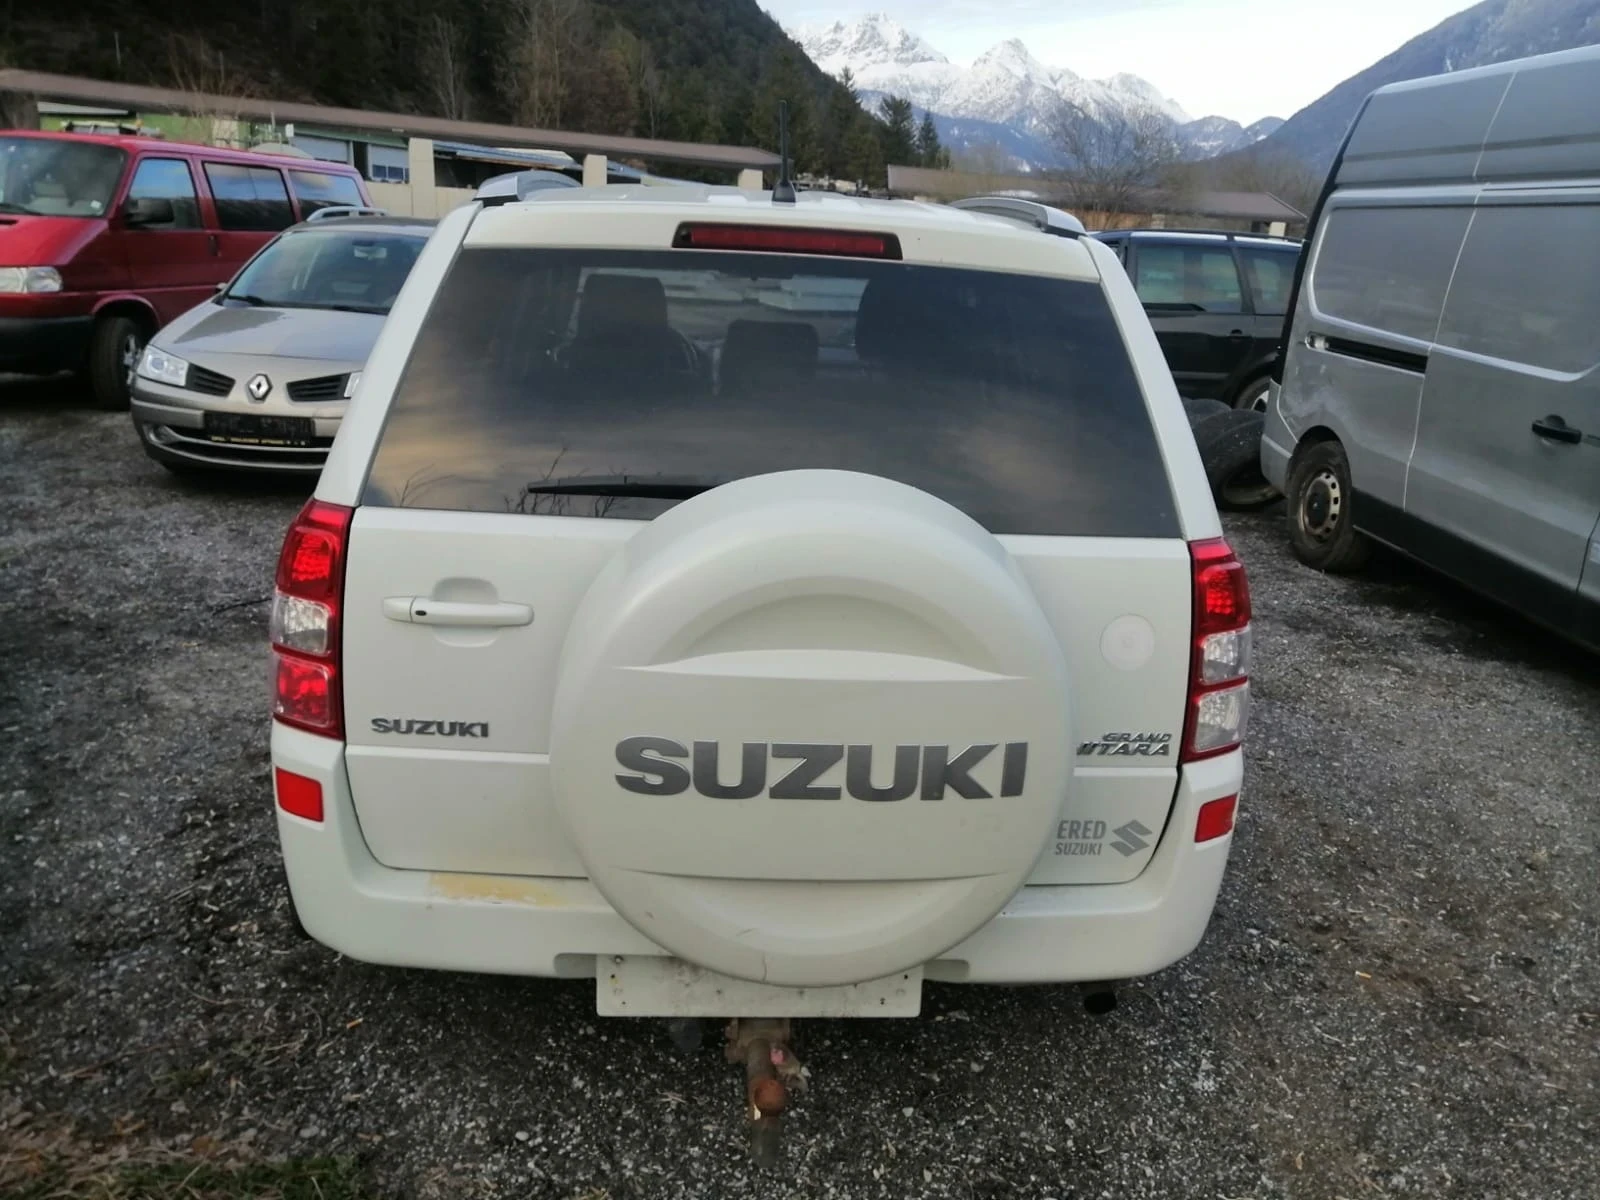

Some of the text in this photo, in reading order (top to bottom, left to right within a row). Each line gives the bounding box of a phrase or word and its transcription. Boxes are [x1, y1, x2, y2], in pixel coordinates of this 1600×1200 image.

[371, 718, 489, 738] SUZUKI
[1102, 732, 1172, 743] GRAND
[615, 736, 1029, 802] SUZUKI
[1056, 820, 1107, 840] ERED
[1055, 842, 1103, 856] SUZUKI
